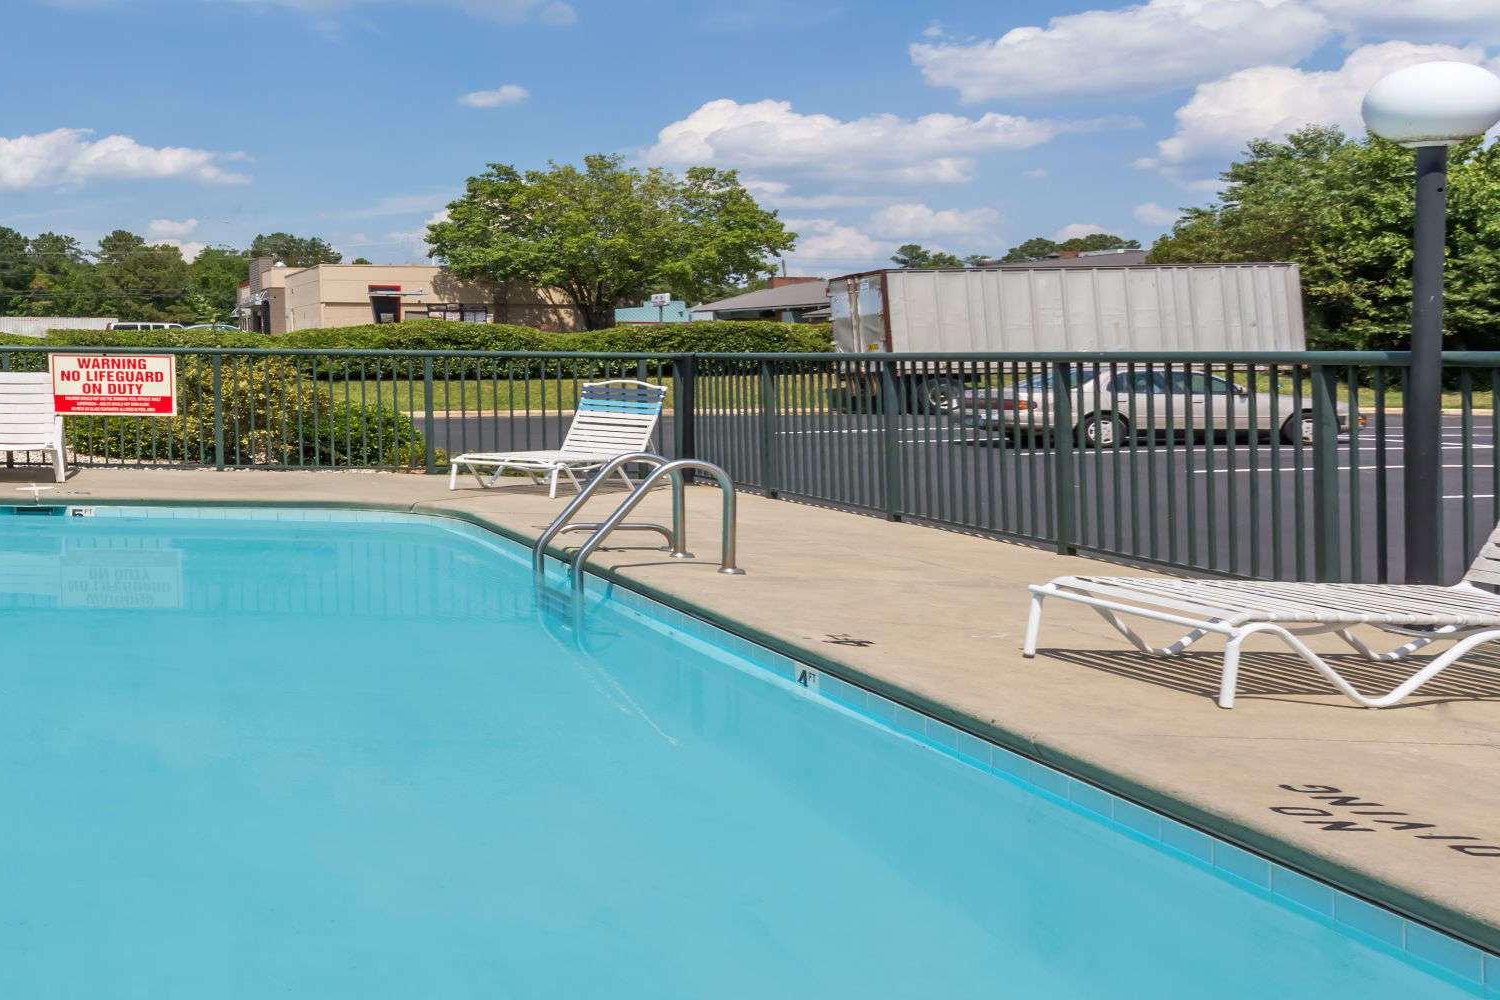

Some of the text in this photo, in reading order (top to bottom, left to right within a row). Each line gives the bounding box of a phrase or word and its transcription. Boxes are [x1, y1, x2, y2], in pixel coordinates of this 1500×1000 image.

[77, 358, 147, 370] WARNING
[60, 370, 164, 383] NO LIFEGUARD
[82, 383, 144, 395] ON DUTY
[797, 669, 809, 687] 4
[1269, 806, 1378, 832] NO
[1277, 783, 1500, 857] DIVING
